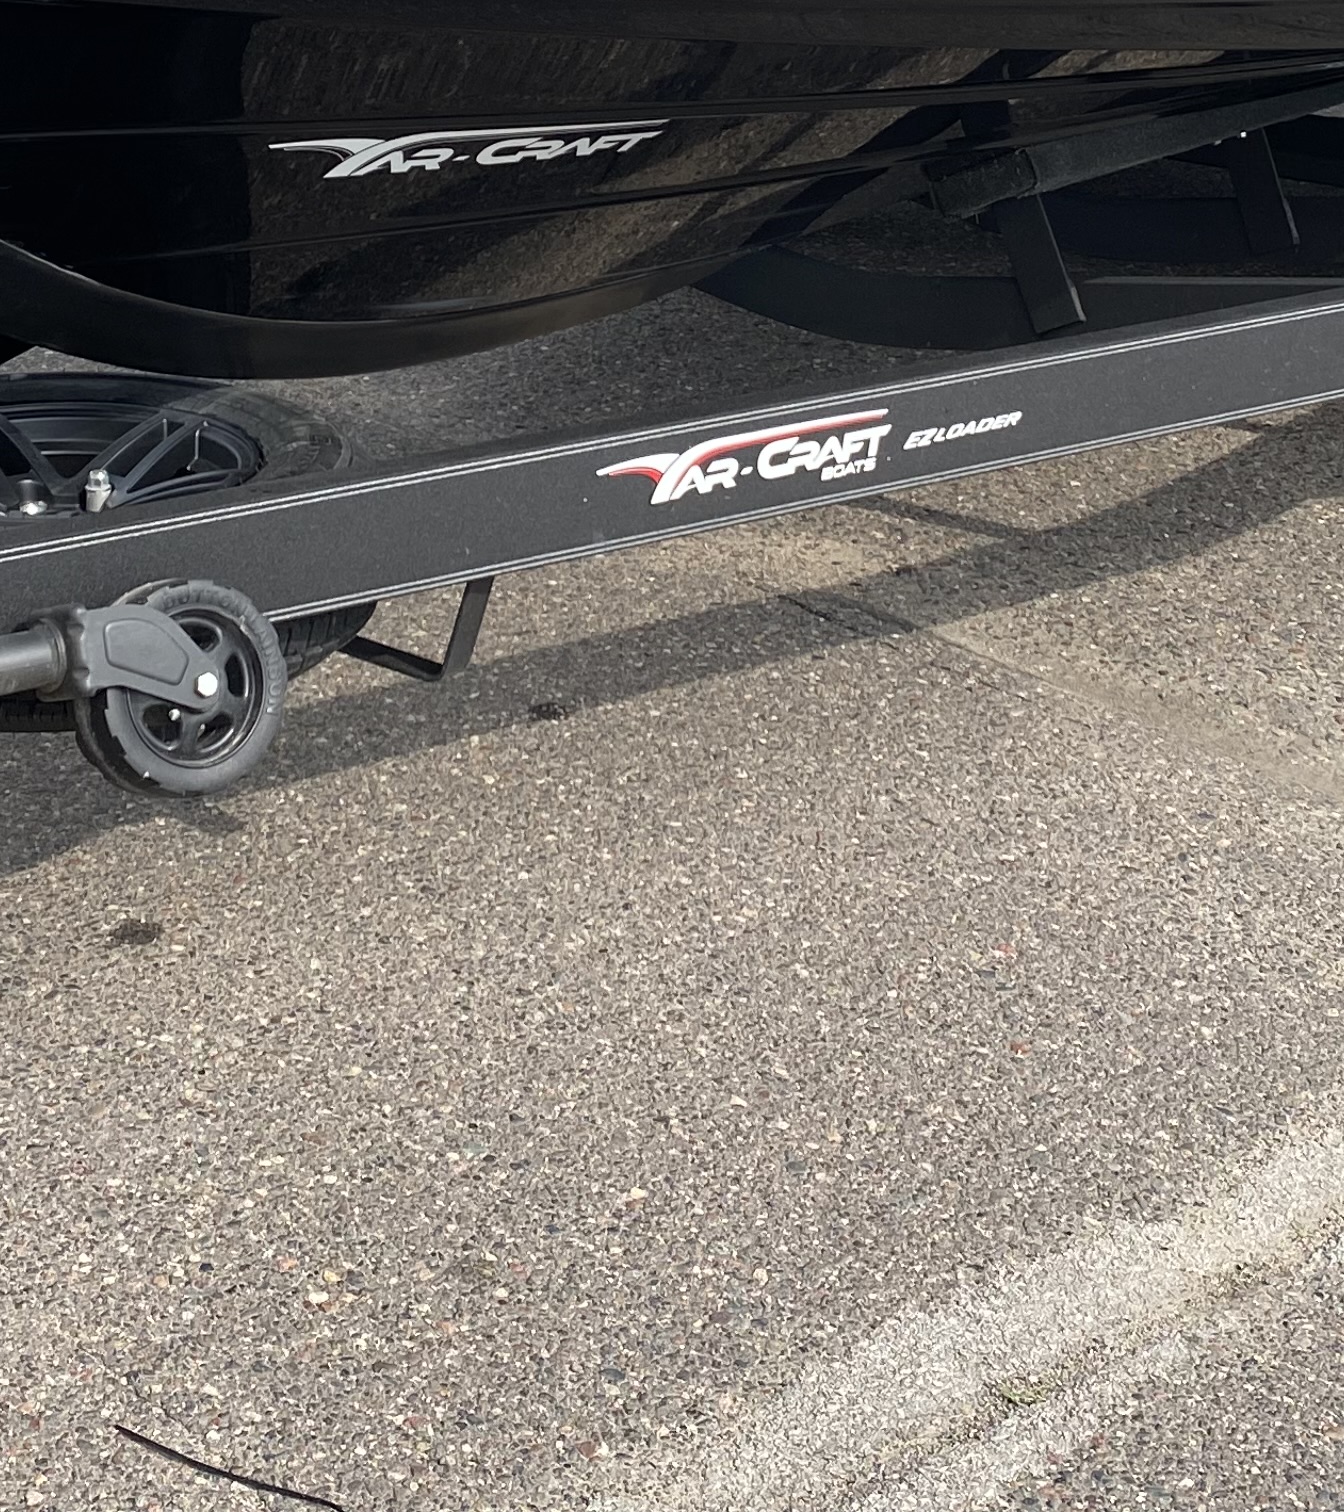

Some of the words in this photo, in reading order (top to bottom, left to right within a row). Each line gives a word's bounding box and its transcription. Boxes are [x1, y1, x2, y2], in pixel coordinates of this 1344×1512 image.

[268, 118, 671, 179] YAR-CRAFT
[596, 409, 892, 505] YAR-CRAFT
[820, 456, 877, 482] BOATS
